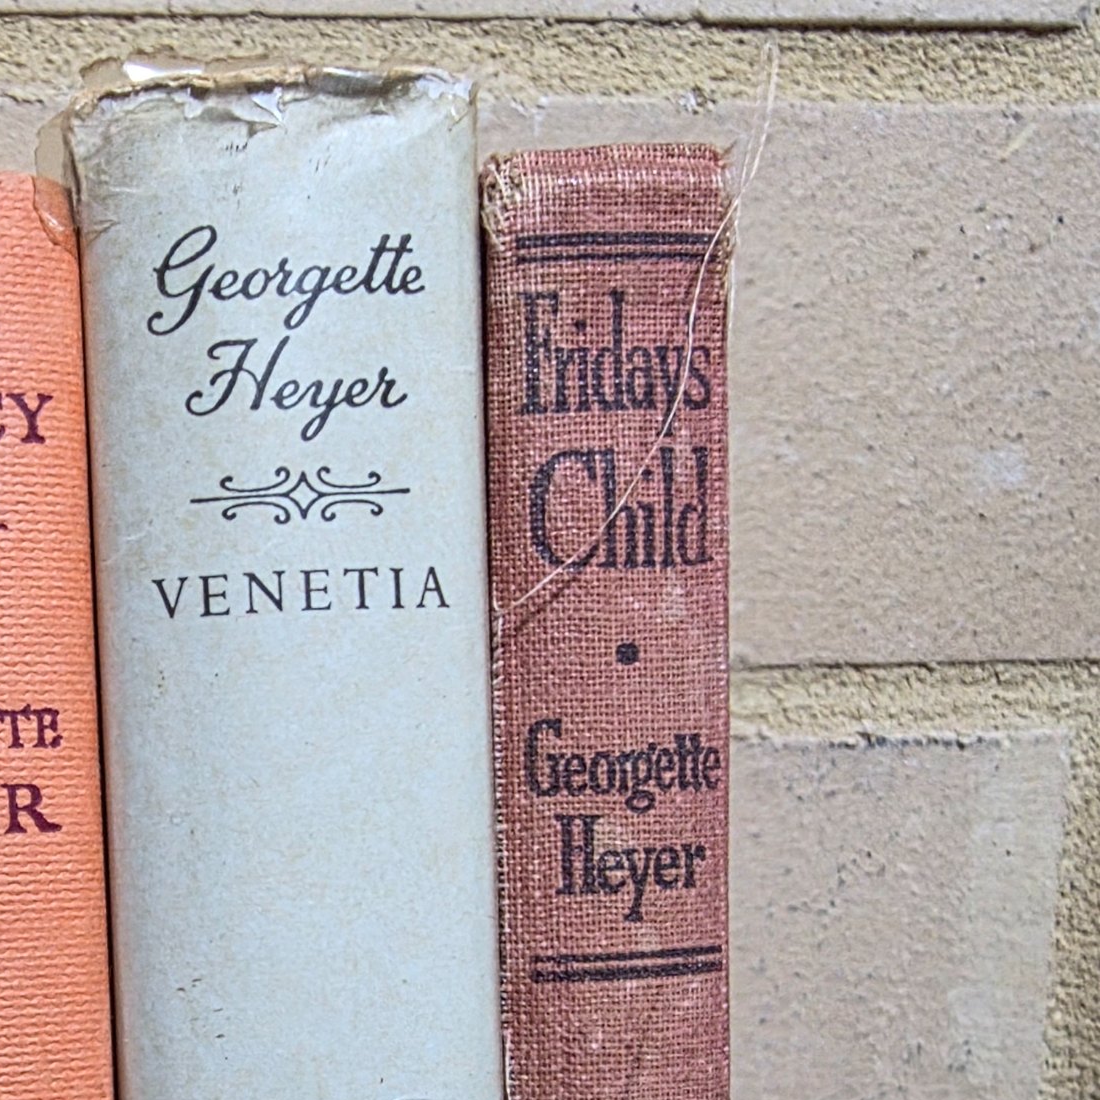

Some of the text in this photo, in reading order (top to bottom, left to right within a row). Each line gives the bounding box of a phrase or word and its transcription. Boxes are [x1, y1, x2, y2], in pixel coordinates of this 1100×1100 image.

[147, 224, 426, 336] Georgette
[185, 335, 409, 442] Heyer
[528, 445, 714, 574] Child
[151, 565, 451, 620] VENETIA
[525, 718, 722, 815] Georgette
[554, 812, 707, 922] Heyer
